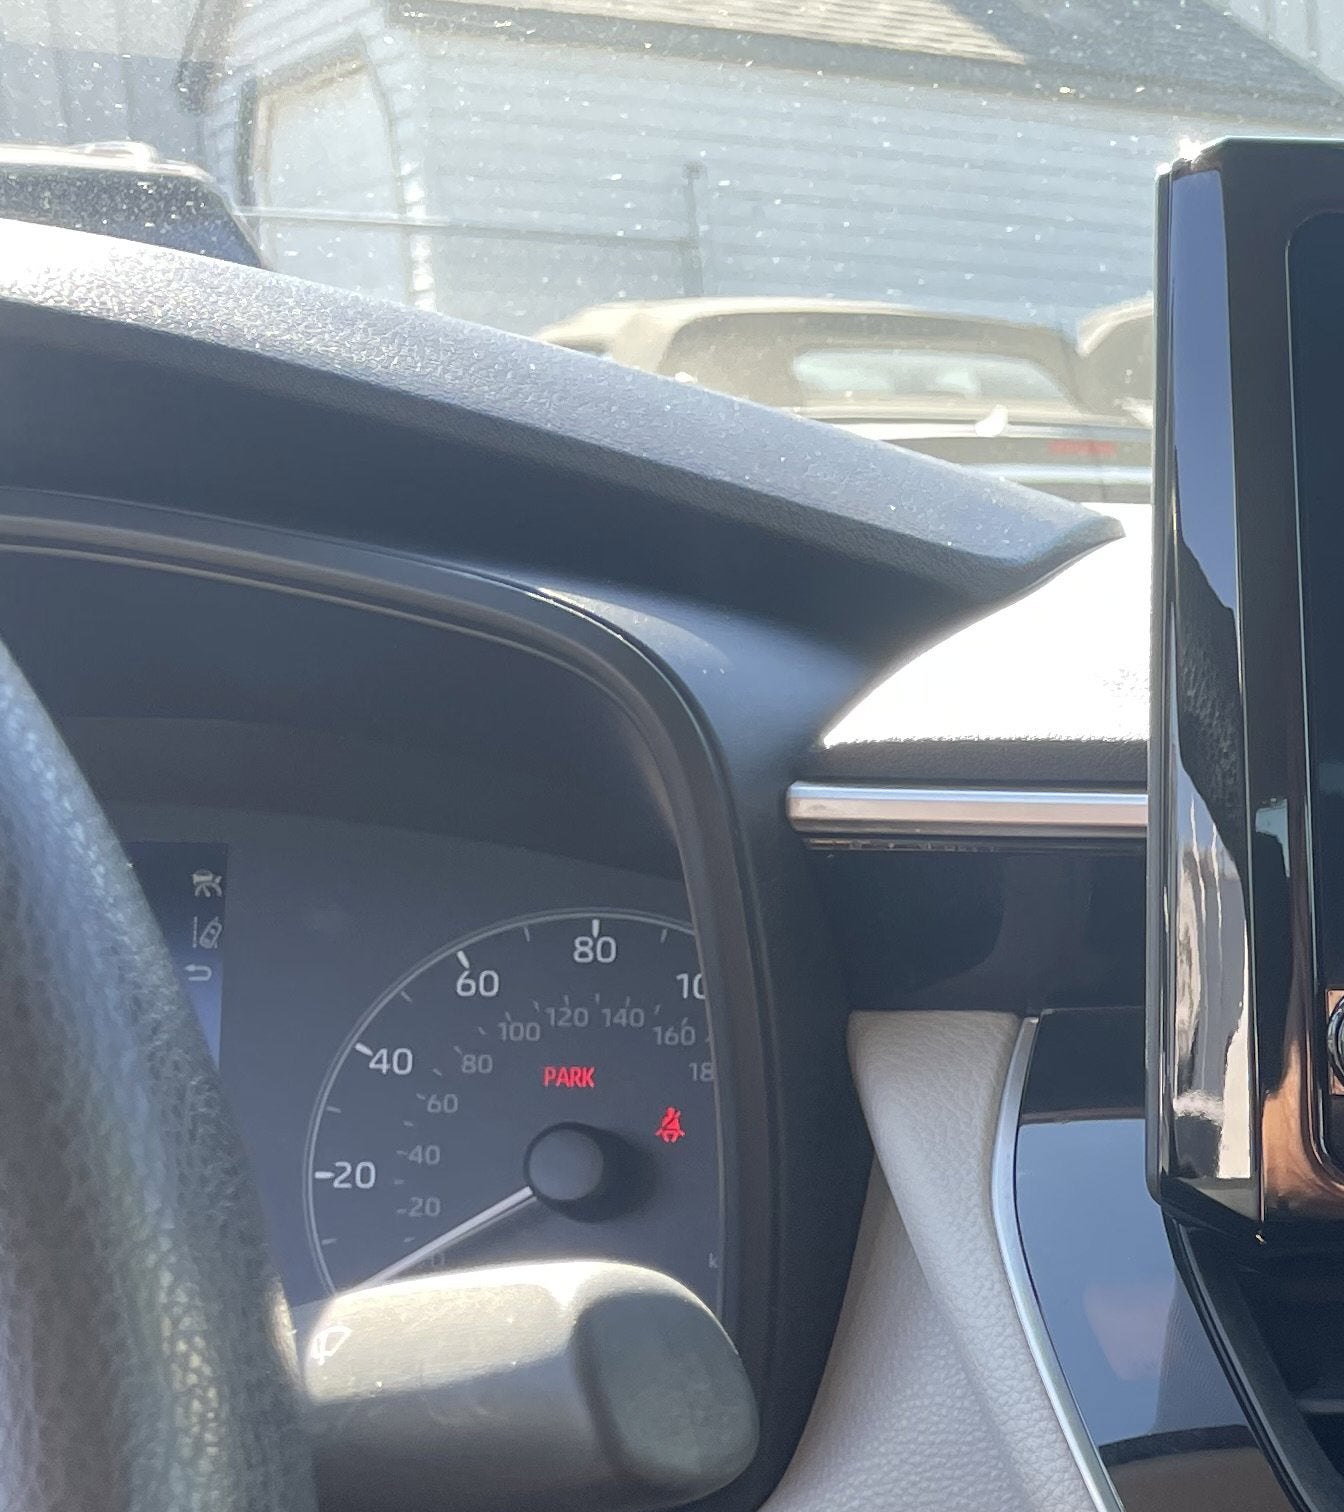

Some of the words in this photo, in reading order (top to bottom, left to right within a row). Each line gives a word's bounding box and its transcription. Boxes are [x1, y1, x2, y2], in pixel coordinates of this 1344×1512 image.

[574, 935, 616, 963] 80
[456, 970, 499, 996] 60
[677, 973, 705, 999] 10
[546, 1007, 589, 1027] 120
[602, 1008, 645, 1027] 140
[498, 1022, 540, 1041] 100
[653, 1026, 696, 1045] 160
[368, 1048, 413, 1074] 40
[461, 1054, 493, 1074] 80
[544, 1067, 594, 1088] PARK
[689, 1061, 714, 1082] 18
[426, 1093, 458, 1113] 60
[408, 1145, 441, 1165] 40
[333, 1162, 375, 1188] 20
[409, 1197, 441, 1217] 20
